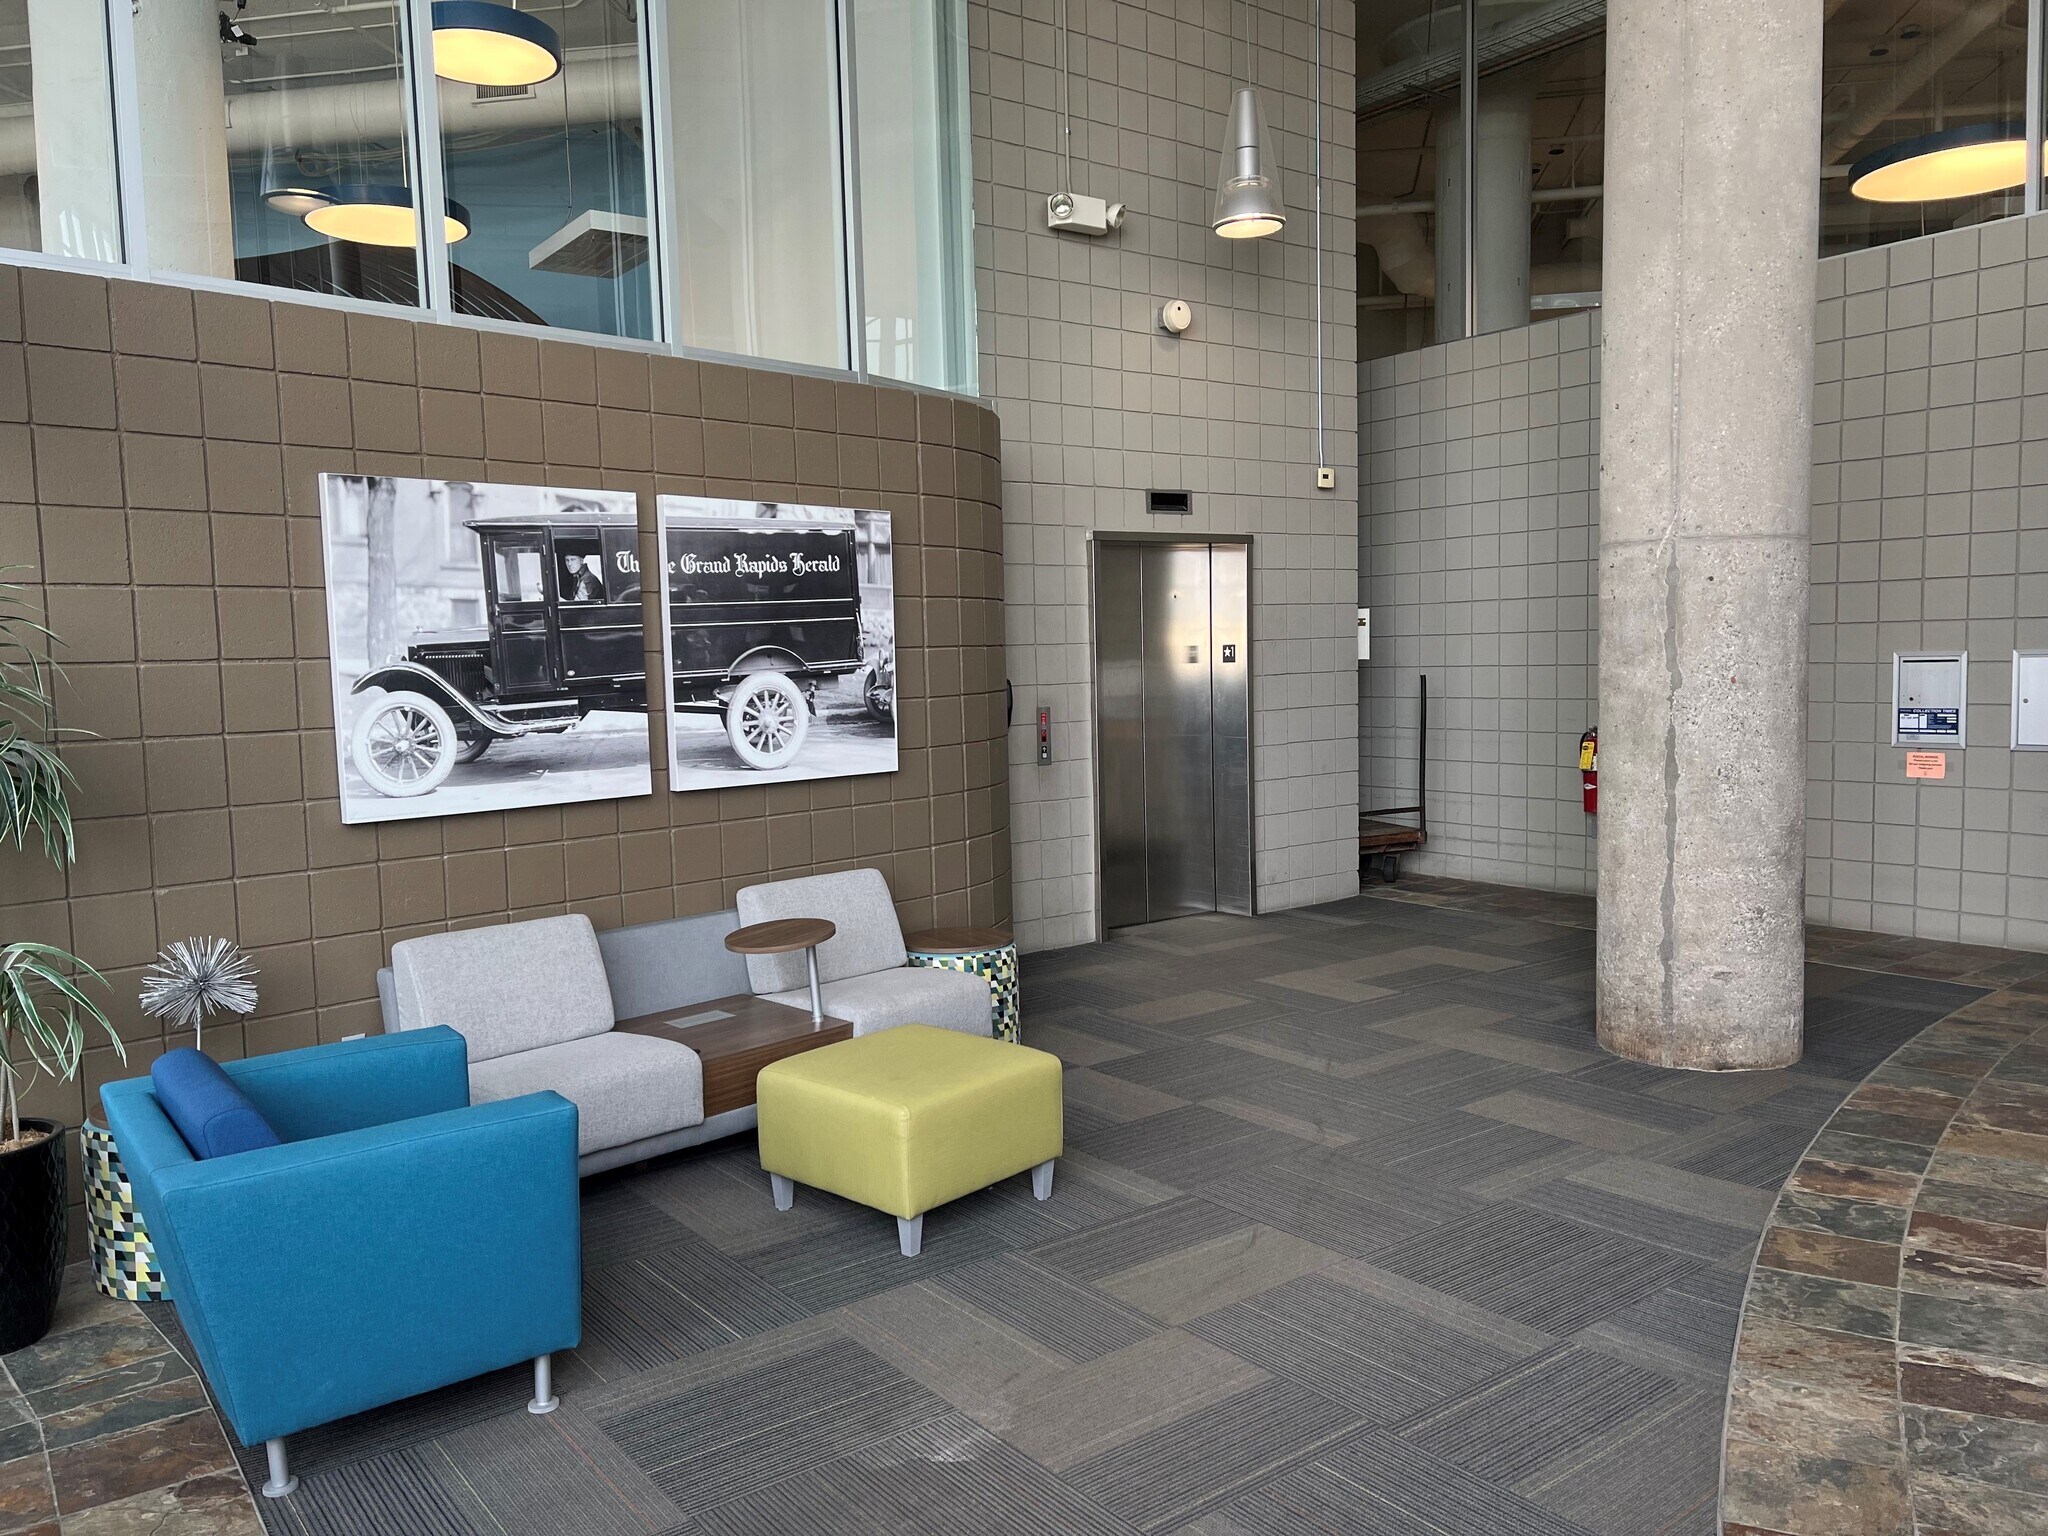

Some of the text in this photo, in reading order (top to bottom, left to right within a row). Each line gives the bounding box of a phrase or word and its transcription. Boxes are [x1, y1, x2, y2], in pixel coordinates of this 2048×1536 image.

[680, 552, 731, 575] Grand
[734, 552, 788, 579] Rapids
[790, 551, 841, 577] Herald
